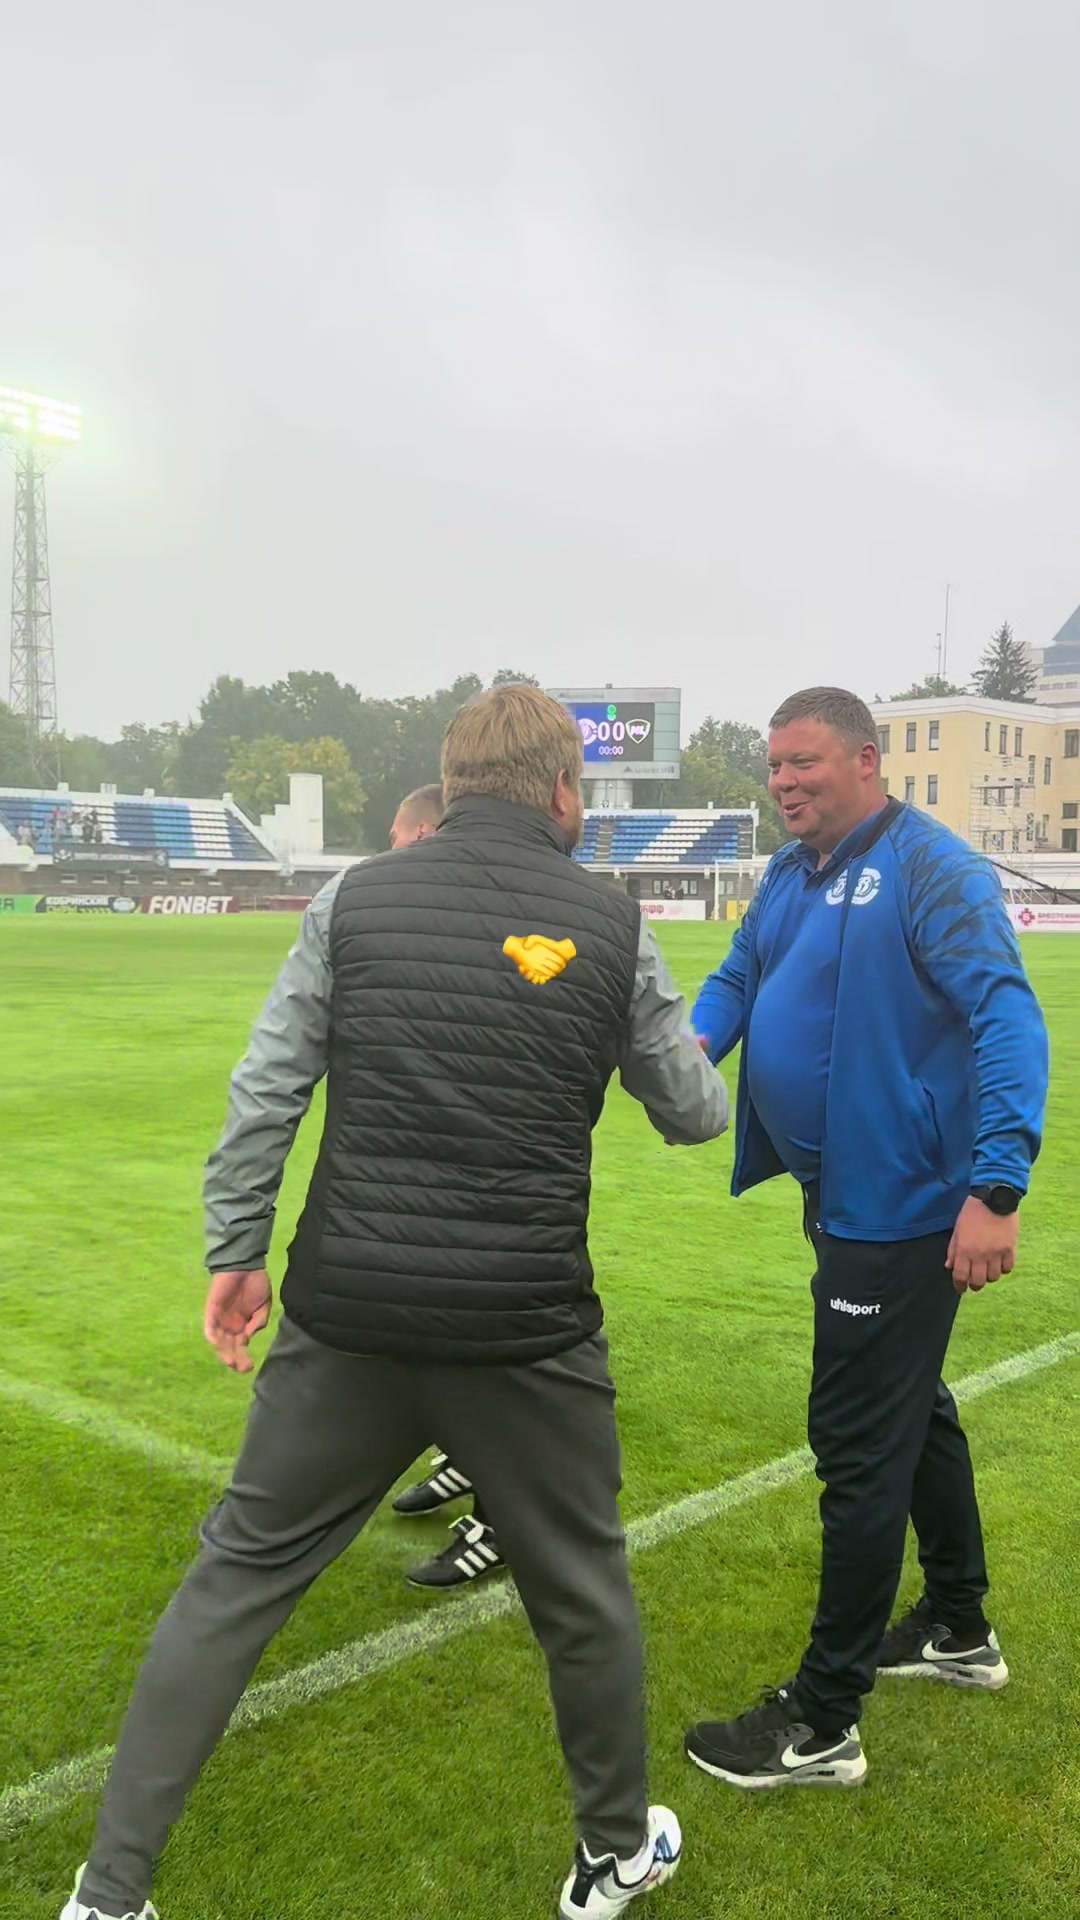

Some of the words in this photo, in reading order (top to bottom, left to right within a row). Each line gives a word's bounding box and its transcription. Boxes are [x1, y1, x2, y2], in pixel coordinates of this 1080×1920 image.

[598, 746, 624, 755] 00:00
[149, 896, 233, 914] FONBET
[830, 1298, 881, 1316] uhlsport
